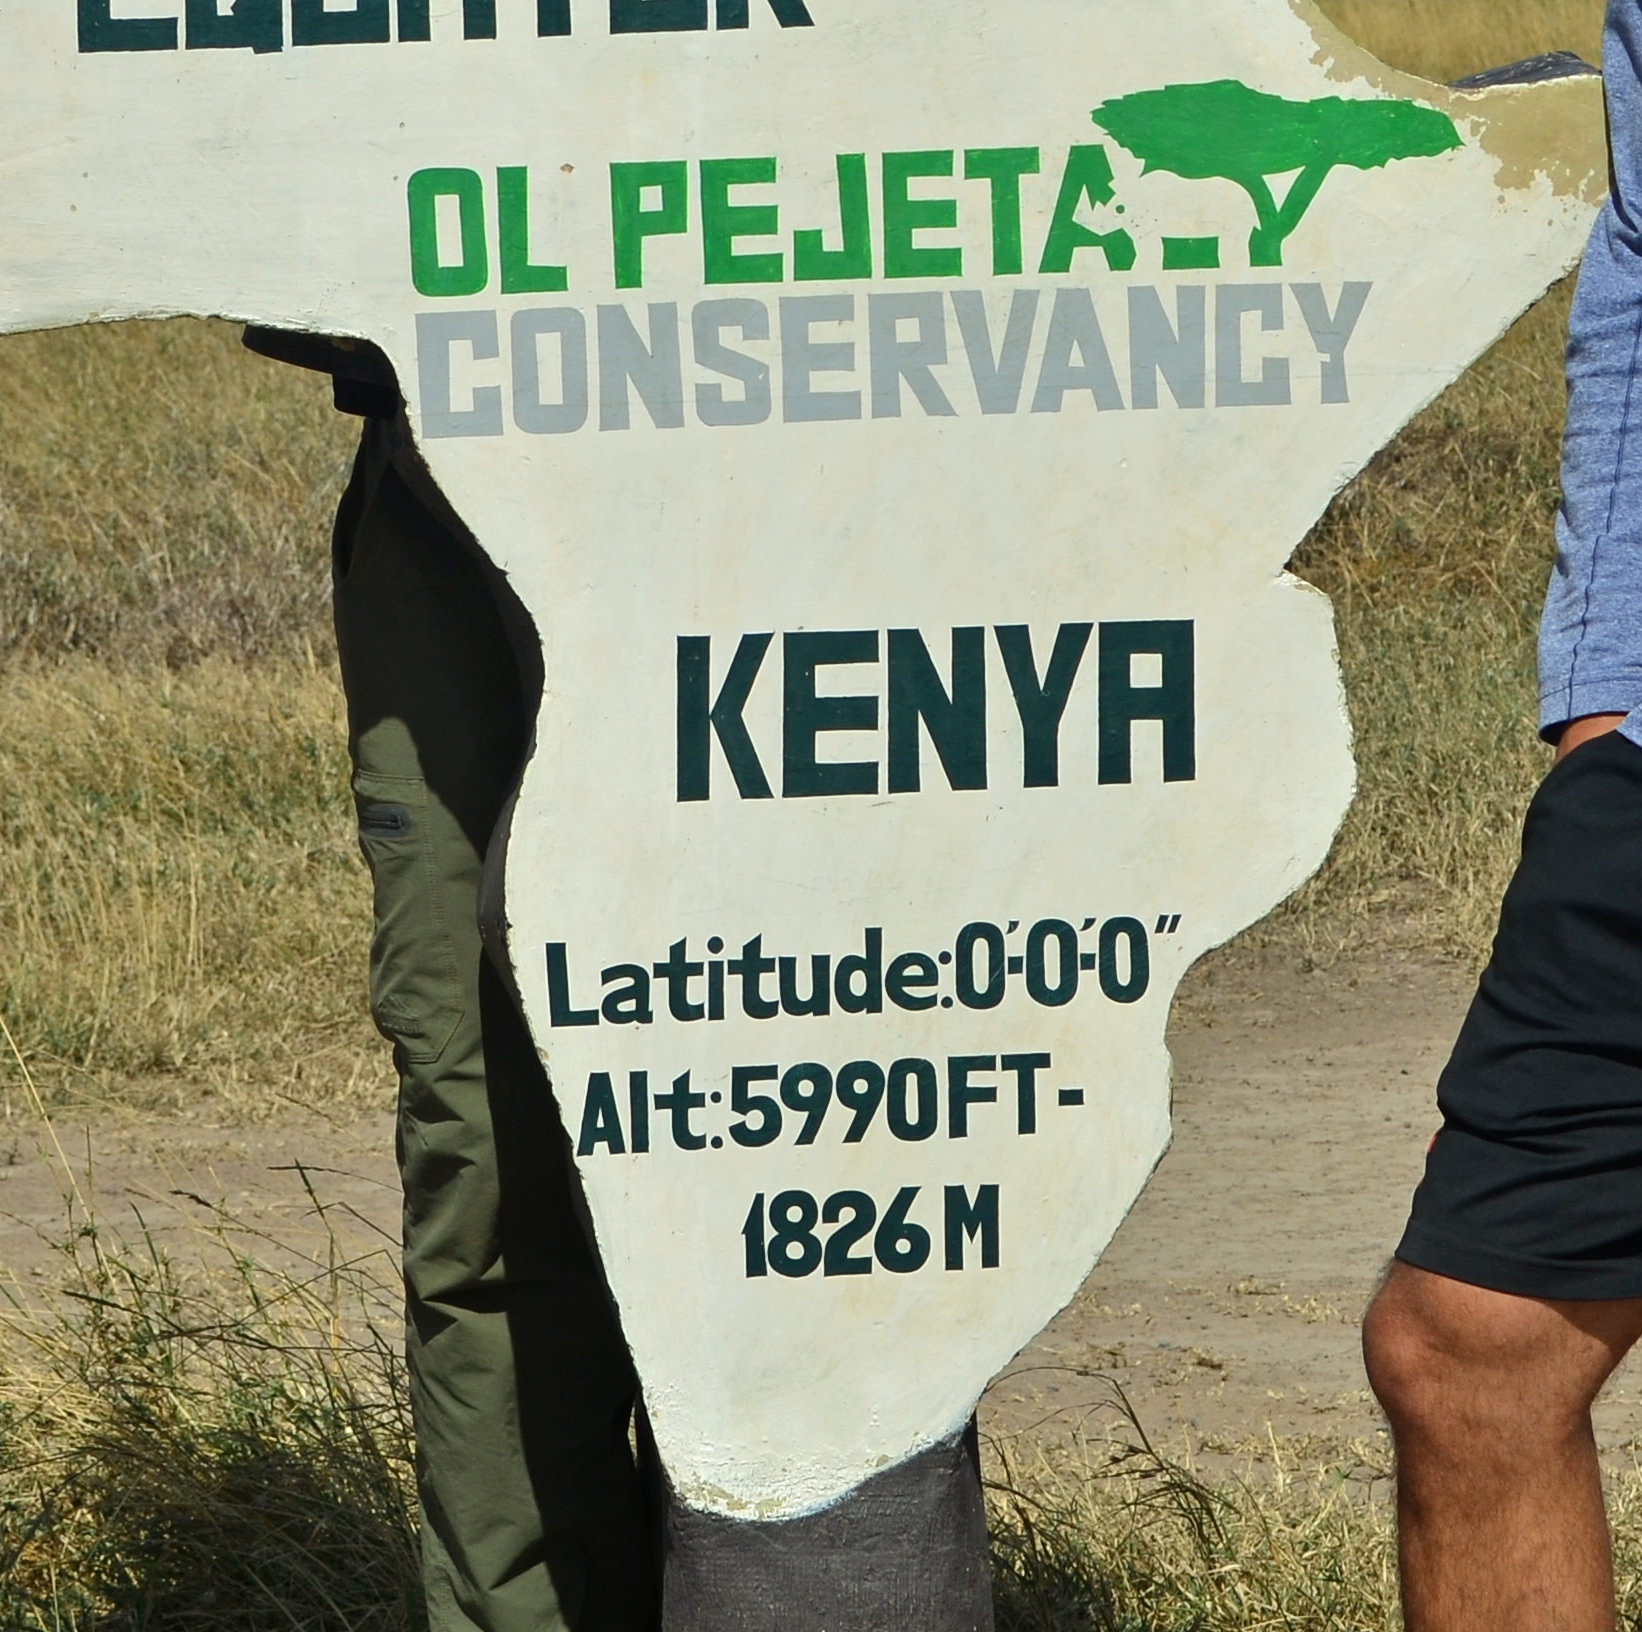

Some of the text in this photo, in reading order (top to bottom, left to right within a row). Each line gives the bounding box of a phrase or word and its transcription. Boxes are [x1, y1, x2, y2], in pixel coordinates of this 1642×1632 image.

[407, 144, 1138, 296] OL PEJETA
[414, 279, 1373, 438] CONSERVANCY
[676, 619, 1197, 803] KENYA
[741, 1184, 1000, 1279] 1826 M
